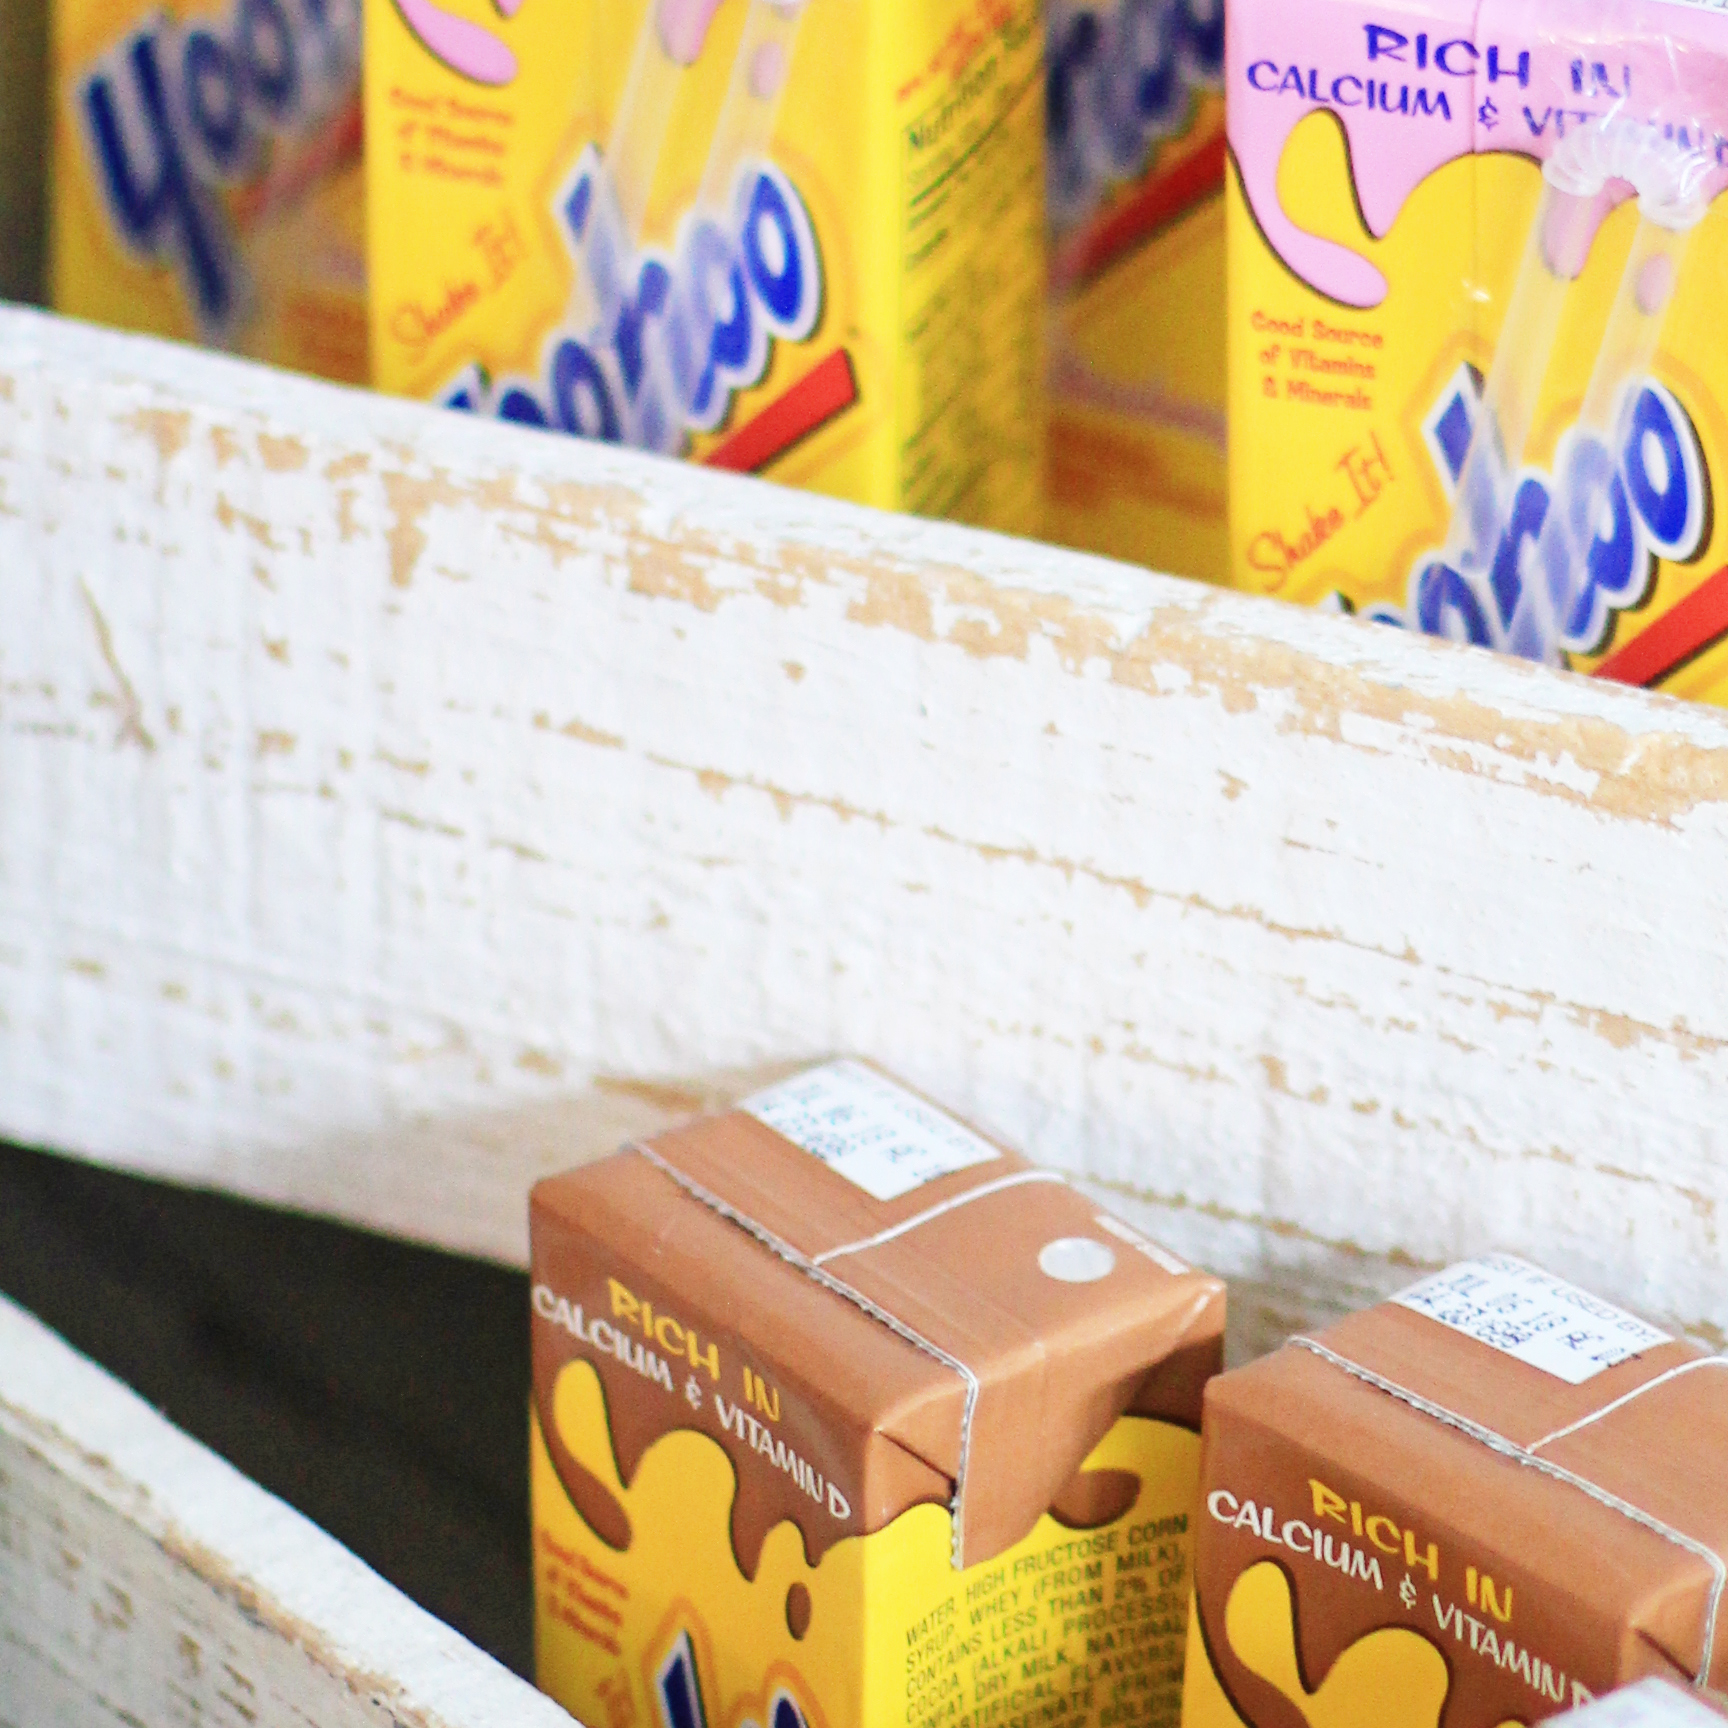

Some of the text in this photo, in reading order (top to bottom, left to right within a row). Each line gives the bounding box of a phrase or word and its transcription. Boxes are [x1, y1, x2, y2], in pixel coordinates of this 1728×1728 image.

[1247, 60, 1452, 122] CALCIUM
[1477, 97, 1499, 132] &
[1363, 23, 1632, 99] RICH IN
[1247, 504, 1346, 593] Shake
[608, 1277, 780, 1422] RICH IN
[533, 1284, 674, 1391] CALCIUM
[715, 1393, 823, 1504] VITAMIN
[827, 1481, 851, 1520] D
[966, 1568, 1005, 1604] HIGH
[1013, 1530, 1119, 1579] FRUCTOSE
[1128, 1513, 1189, 1546] CORN
[969, 1587, 1021, 1627] WHEY
[1033, 1560, 1103, 1601] (FROM
[1207, 1489, 1384, 1592] CALCIUM
[1399, 1573, 1417, 1610] &
[1432, 1593, 1566, 1704] VITAMIN
[1308, 1478, 1513, 1623] RICH IN
[906, 1632, 982, 1699] CONTAINS
[990, 1605, 1038, 1643] LESS
[1049, 1586, 1104, 1617] THAN
[906, 1672, 960, 1724] COCOA
[971, 1628, 1048, 1678] (ALKALI
[974, 1671, 1008, 1703] DRY
